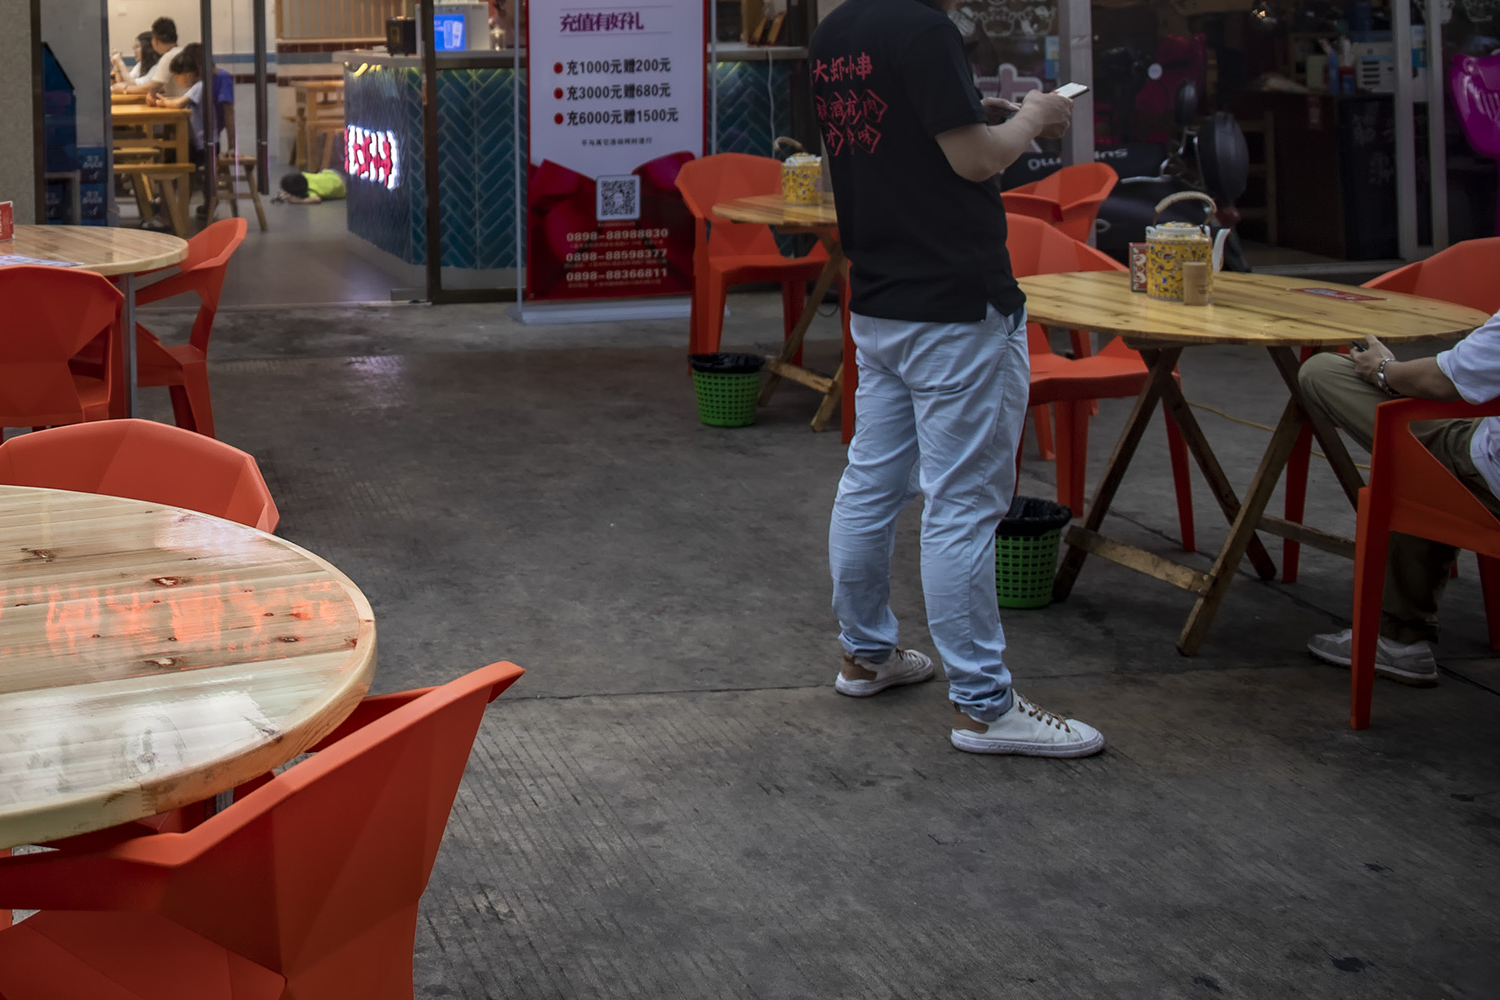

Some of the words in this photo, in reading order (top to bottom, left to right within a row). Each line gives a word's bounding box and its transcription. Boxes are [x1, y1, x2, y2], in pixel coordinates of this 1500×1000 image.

[566, 57, 672, 76] 充1000元赠200元
[812, 51, 874, 84] 大虾小串
[566, 82, 672, 101] 充3000元赠680元
[566, 107, 679, 126] 充6000元赠1500元
